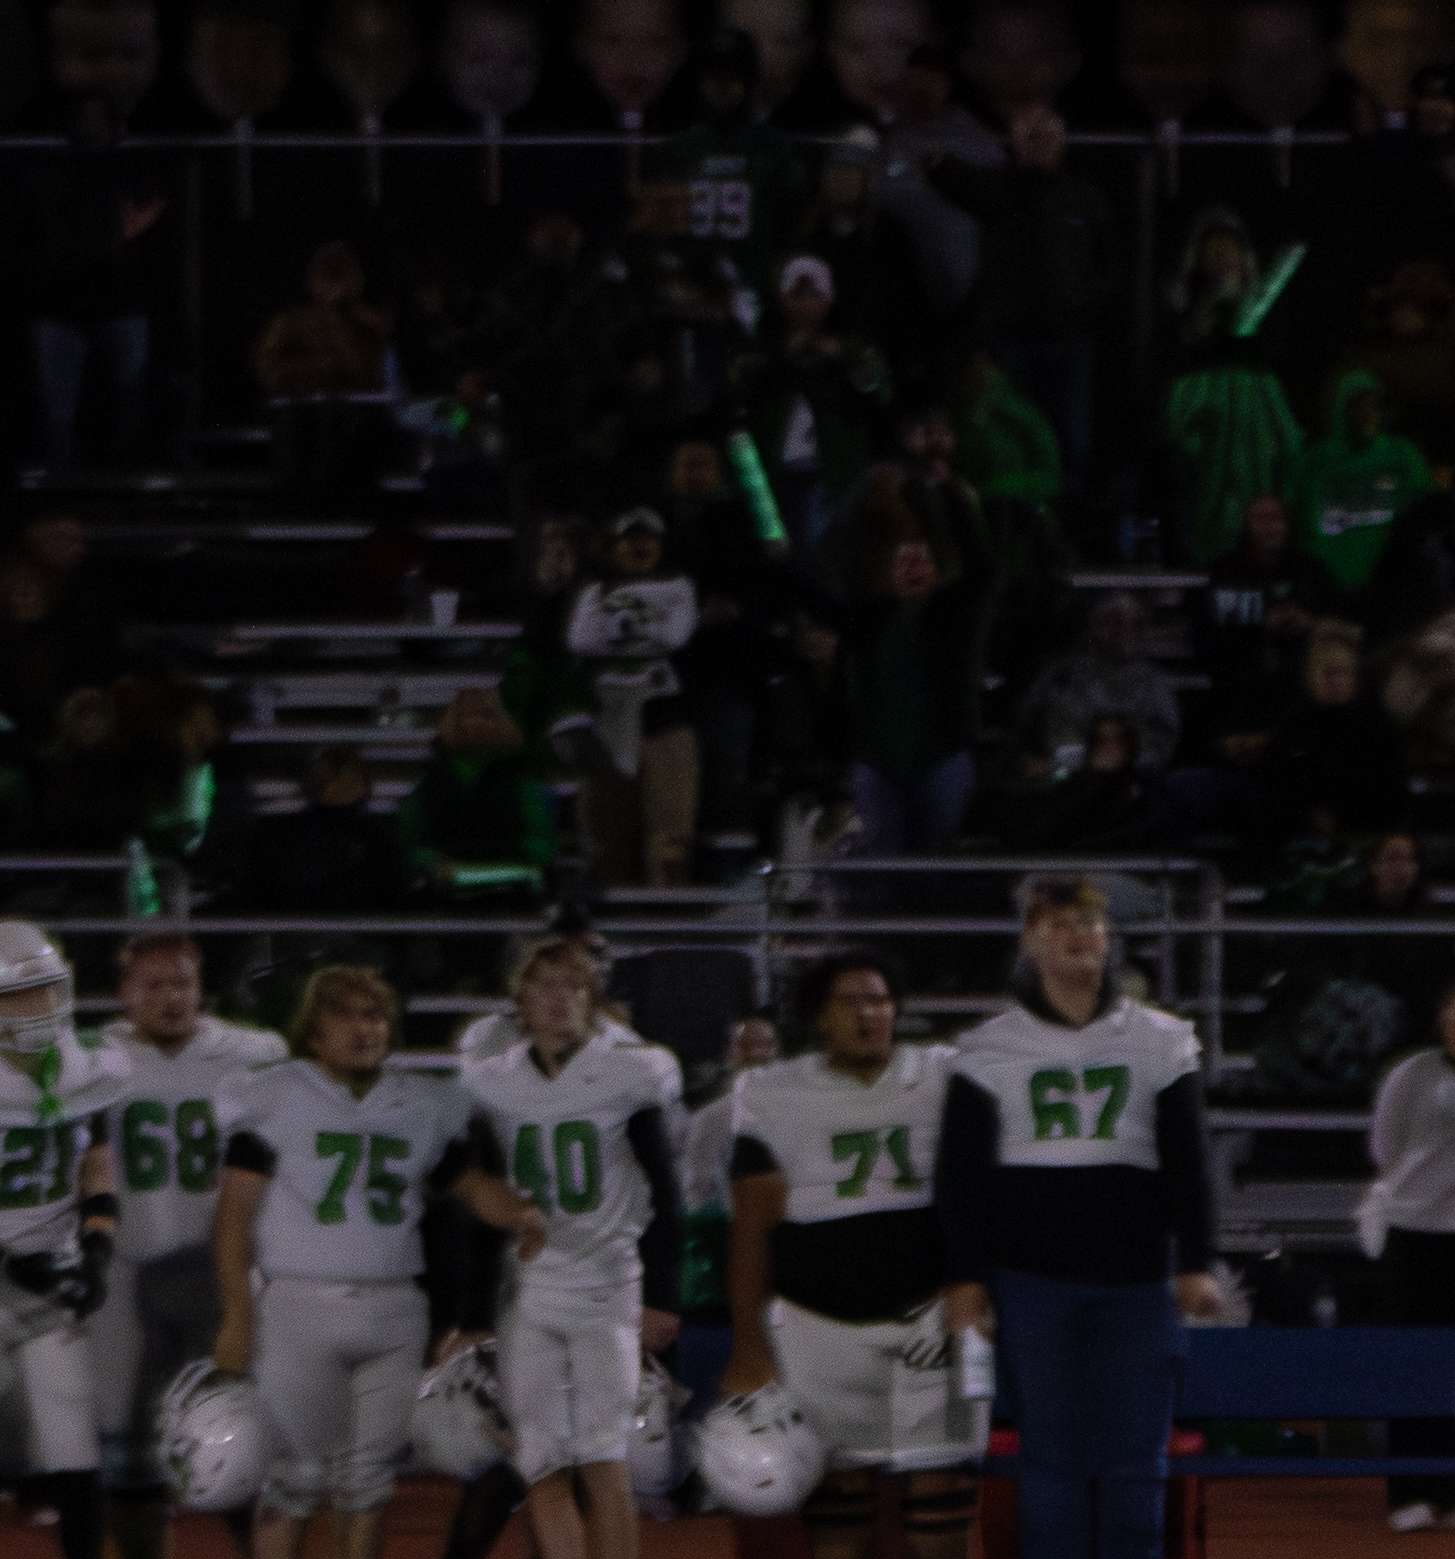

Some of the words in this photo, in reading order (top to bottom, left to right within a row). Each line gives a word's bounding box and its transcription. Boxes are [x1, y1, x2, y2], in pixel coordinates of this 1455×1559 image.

[122, 1099, 219, 1193] 68
[1029, 1065, 1133, 1142] 67
[315, 1131, 410, 1225] 75
[513, 1120, 604, 1215] 40
[830, 1125, 920, 1198] 71
